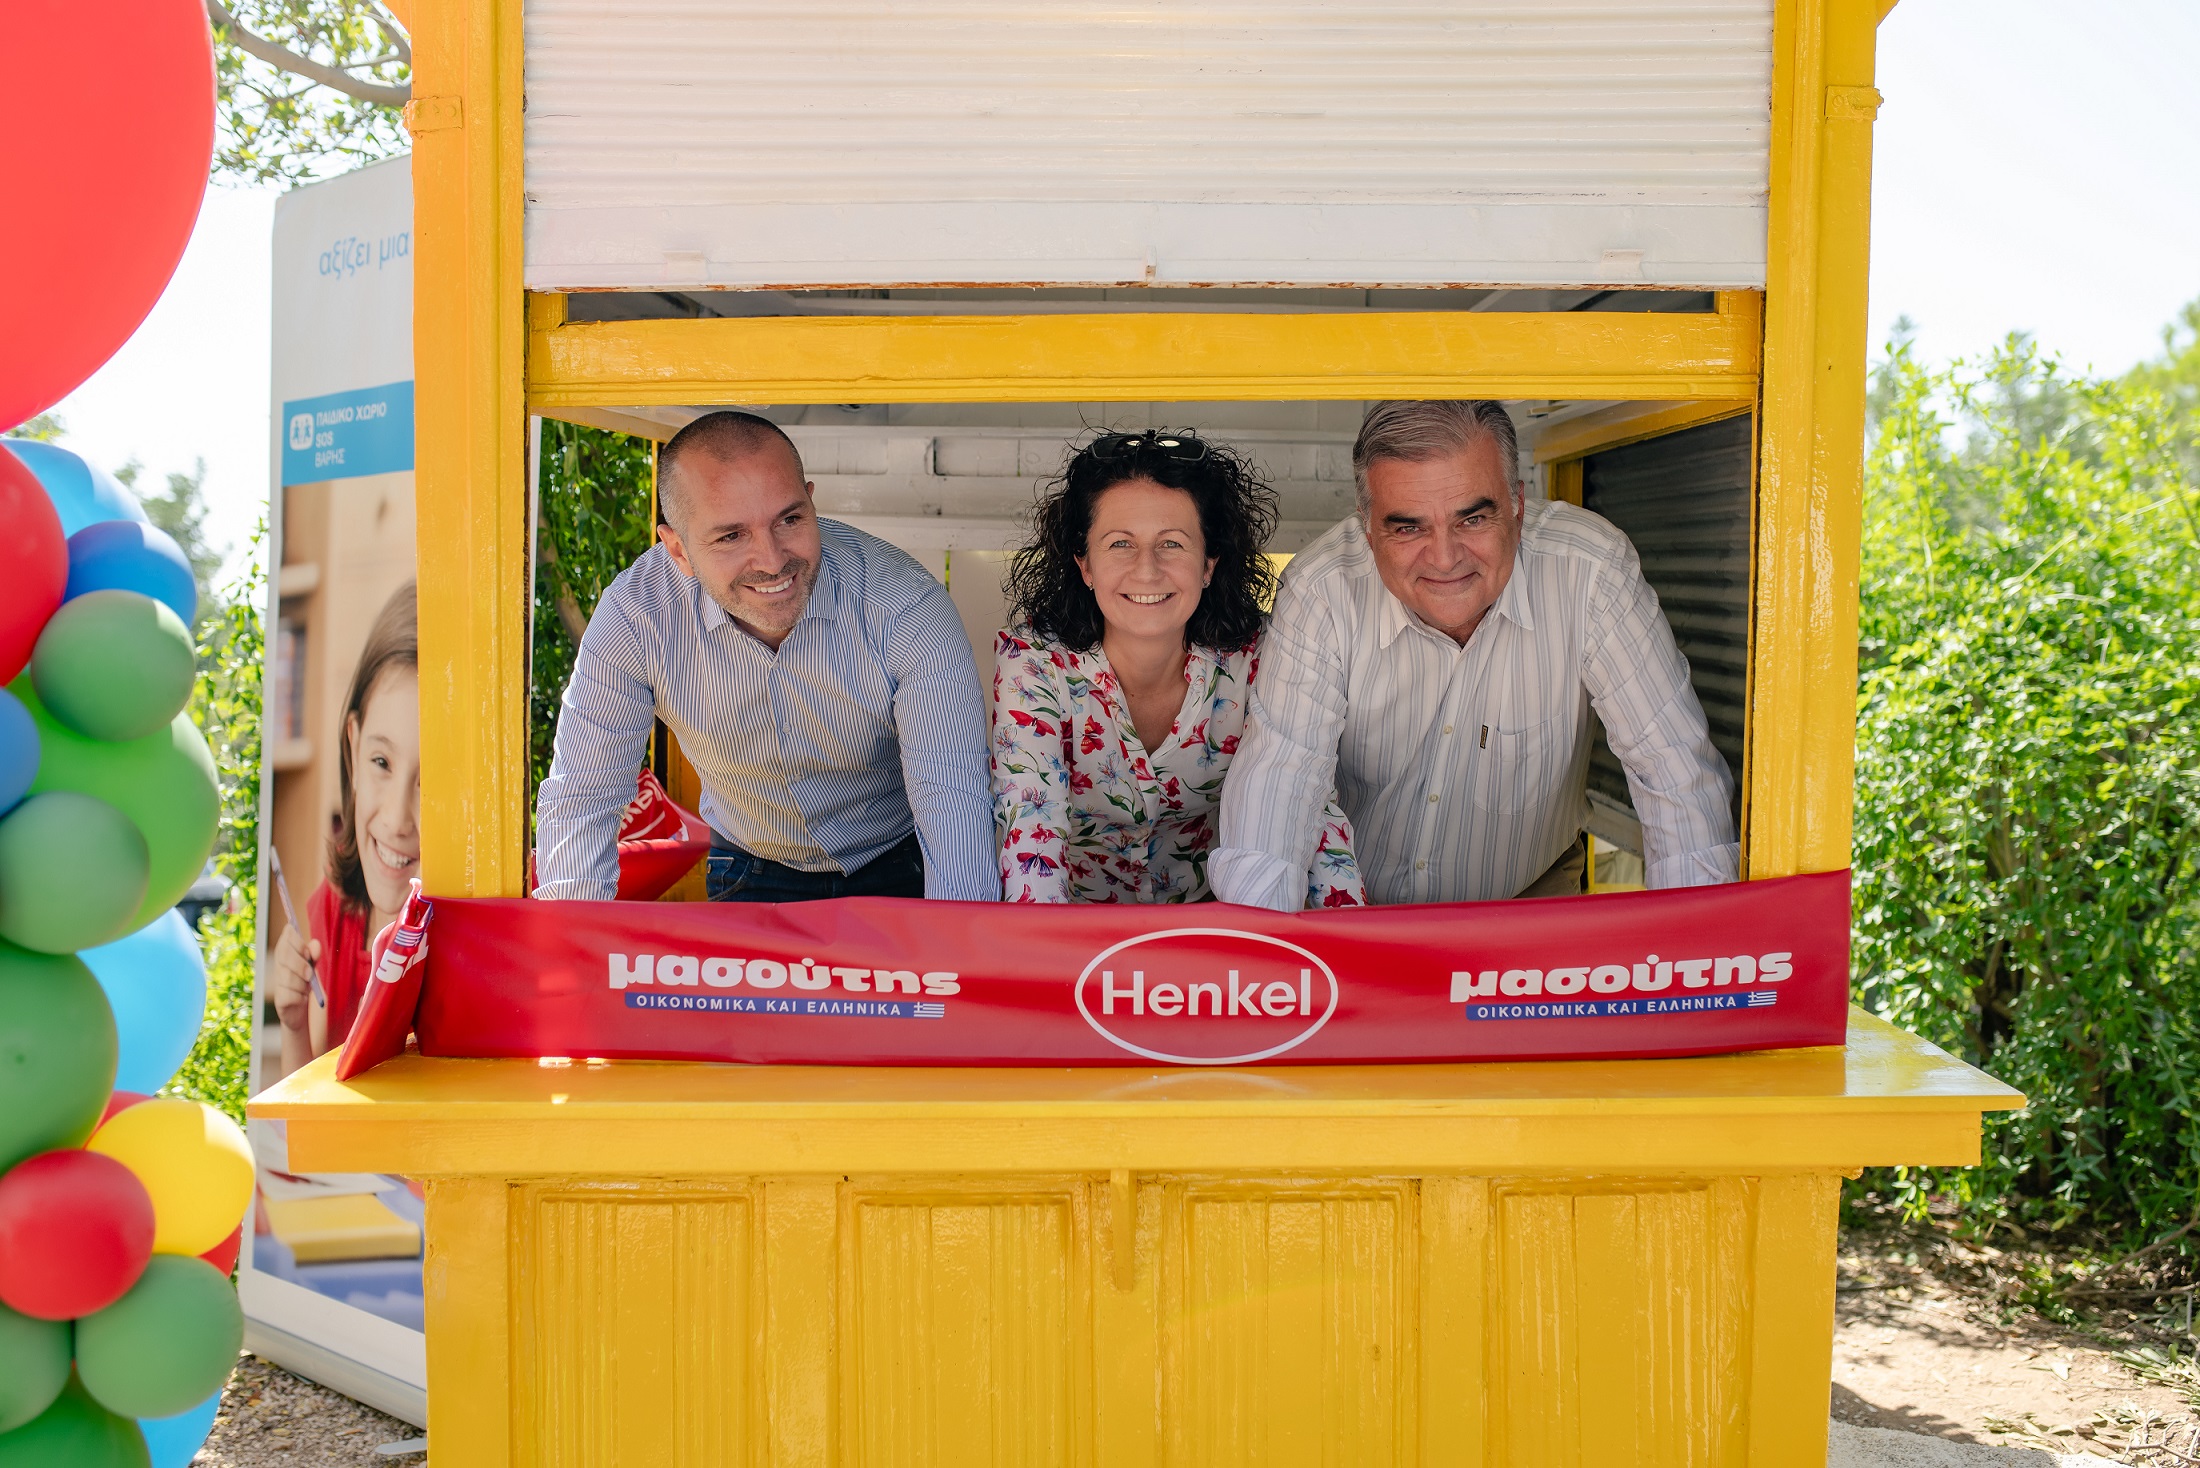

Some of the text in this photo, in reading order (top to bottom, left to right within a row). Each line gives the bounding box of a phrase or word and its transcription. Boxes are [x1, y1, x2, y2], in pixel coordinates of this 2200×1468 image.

[319, 231, 409, 280] αξίζει μια
[315, 401, 387, 427] ΠΑΙΔΙΚΟ ΧΩΡΙΟ
[315, 431, 334, 449] SOS
[314, 448, 346, 468] ΒΑΡΗΣ
[1102, 968, 1312, 1017] Henkel
[636, 995, 901, 1016] ΟΙΚΟΝΟΜΙΚΑ ΚΑΙ ΕΛΛΗΝΙΚΑ
[1477, 996, 1737, 1018] ΟΙΚΟΝΟΜΙΚΑ ΚΑΙ ΕΛΛΗΝΙΚΑ
